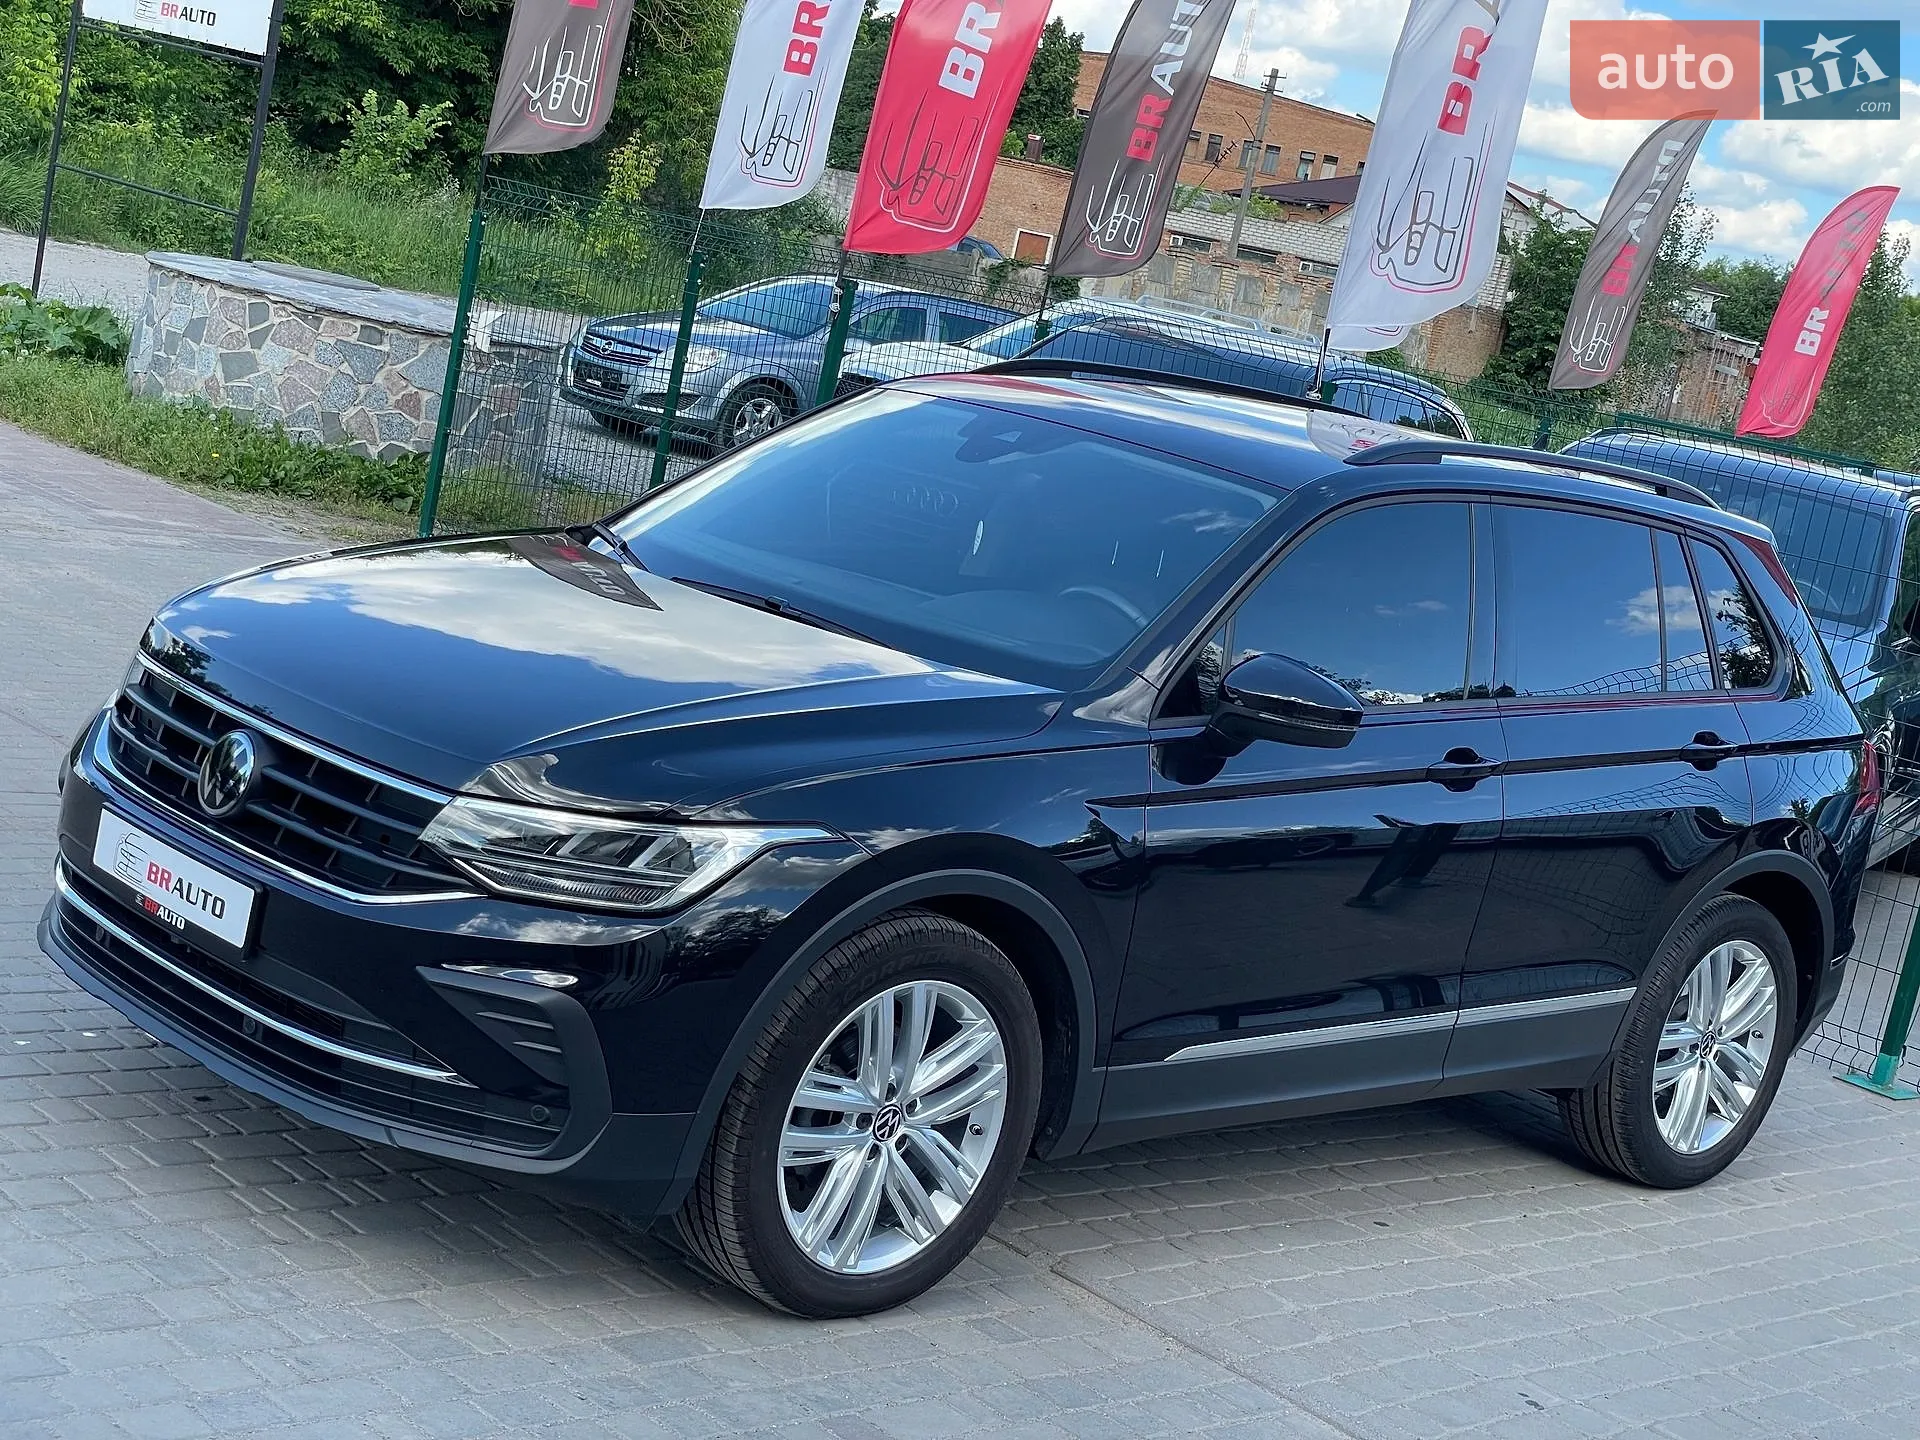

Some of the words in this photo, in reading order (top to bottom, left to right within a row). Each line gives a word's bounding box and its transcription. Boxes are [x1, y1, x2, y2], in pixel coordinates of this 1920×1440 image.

[160, 2, 217, 26] BRAUTO
[146, 861, 226, 920] BRAUTO
[143, 896, 186, 930] BRAUTO
